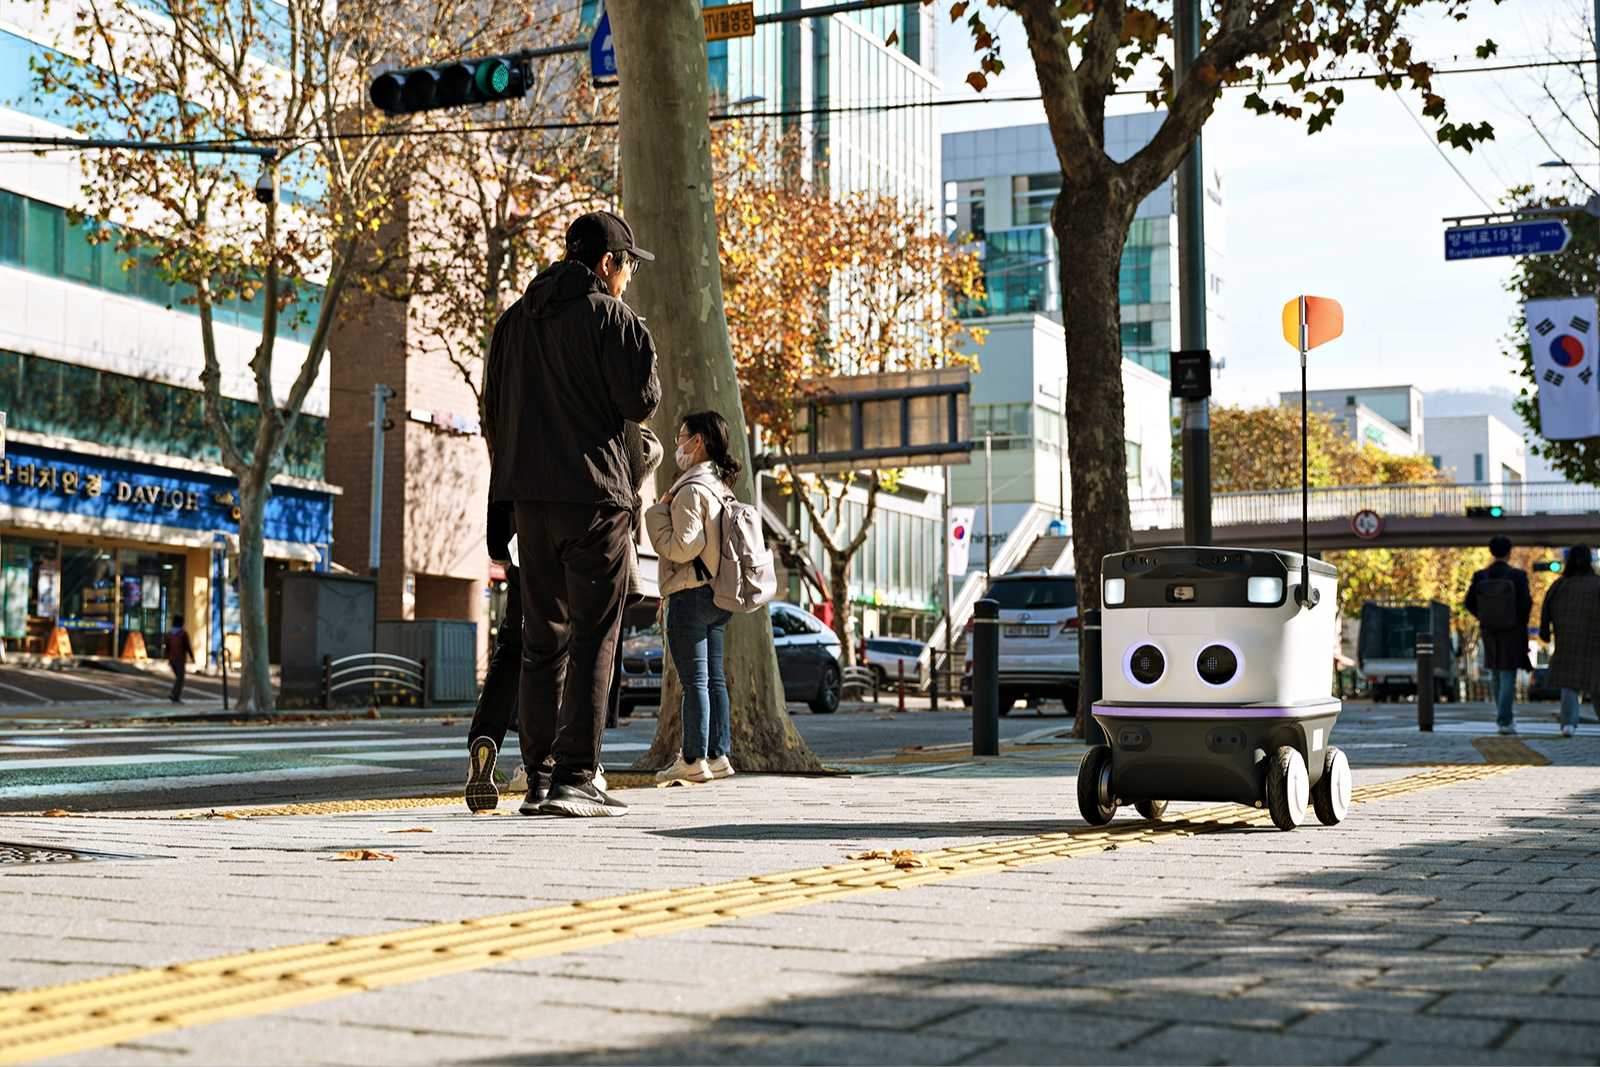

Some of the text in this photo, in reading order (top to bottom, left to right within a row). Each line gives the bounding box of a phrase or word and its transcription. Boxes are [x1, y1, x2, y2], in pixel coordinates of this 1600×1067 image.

[1447, 227, 1522, 247] 방배로19길
[1448, 241, 1540, 258] Bangbae-ro 19-gil
[0, 459, 102, 497] 다비치안경
